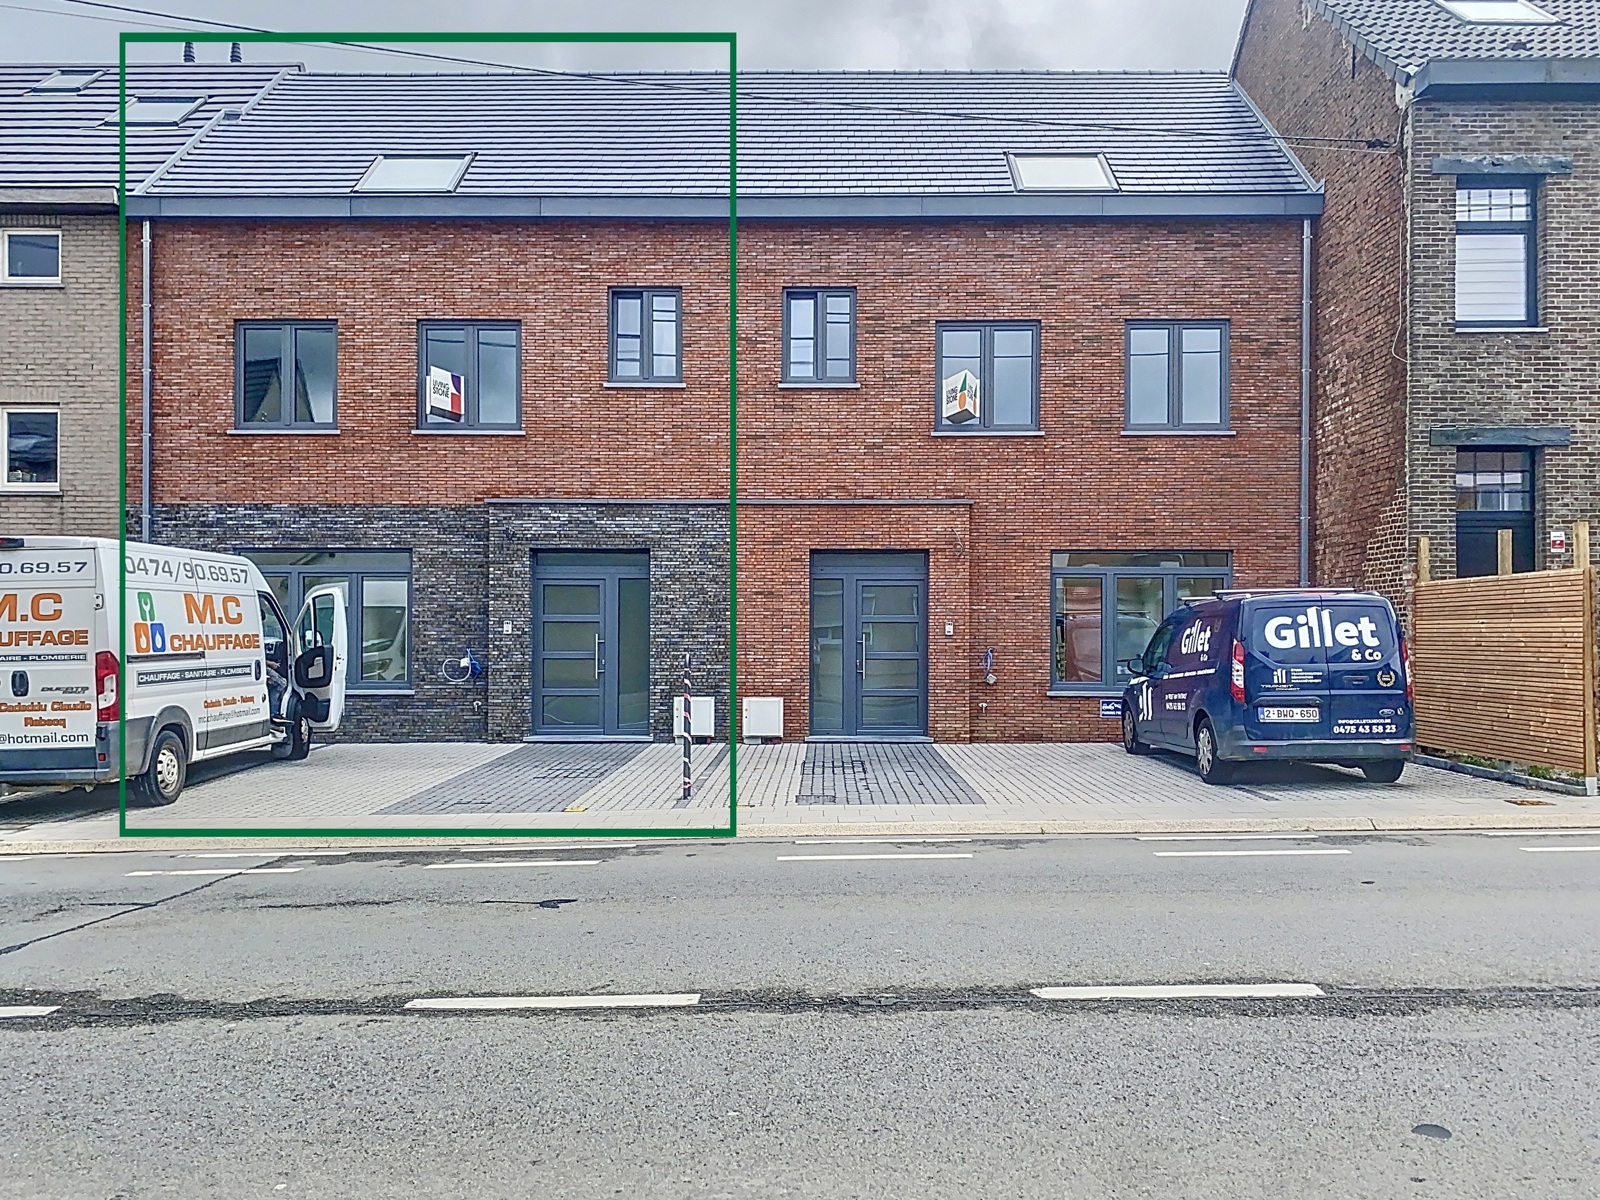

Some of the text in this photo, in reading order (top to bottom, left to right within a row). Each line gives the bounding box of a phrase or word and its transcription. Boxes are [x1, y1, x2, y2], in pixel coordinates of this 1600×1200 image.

[432, 386, 450, 399] STONE
[433, 379, 450, 391] LIVING
[125, 556, 248, 584] 0474/90.69.57
[183, 592, 243, 625] M.C
[1264, 606, 1381, 649] Gillet
[169, 633, 260, 652] CHAUFFAGE
[1181, 619, 1211, 655] Gillet
[1351, 649, 1381, 661] & Co
[138, 672, 180, 683] CHAUFFAGE
[184, 669, 216, 679] SANITAIRE
[221, 666, 251, 676] PLOMBERIE
[1333, 724, 1396, 734] 0475 43 58 23
